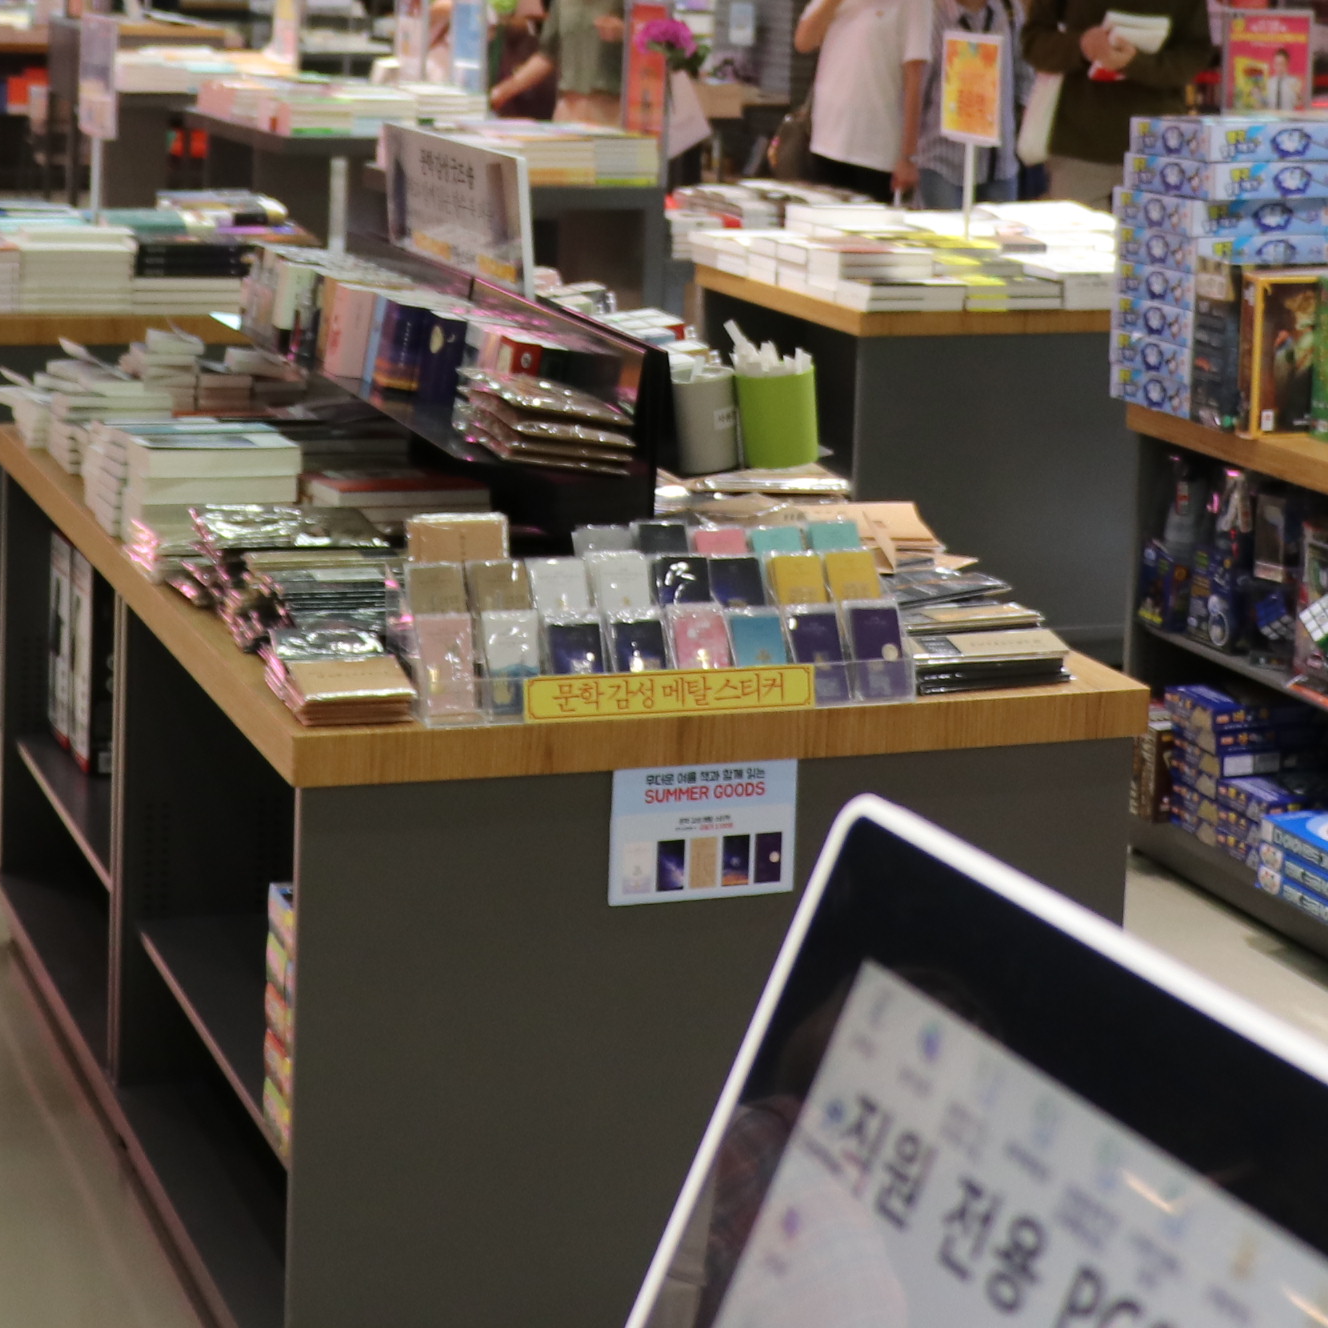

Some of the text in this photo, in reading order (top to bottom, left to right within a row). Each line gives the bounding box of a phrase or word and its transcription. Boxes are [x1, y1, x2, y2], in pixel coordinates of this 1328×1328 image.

[553, 672, 786, 712] 문학 감성 메탈 스티커
[645, 781, 766, 804] SUMMER GOODS
[938, 1175, 1047, 1315] 전용
